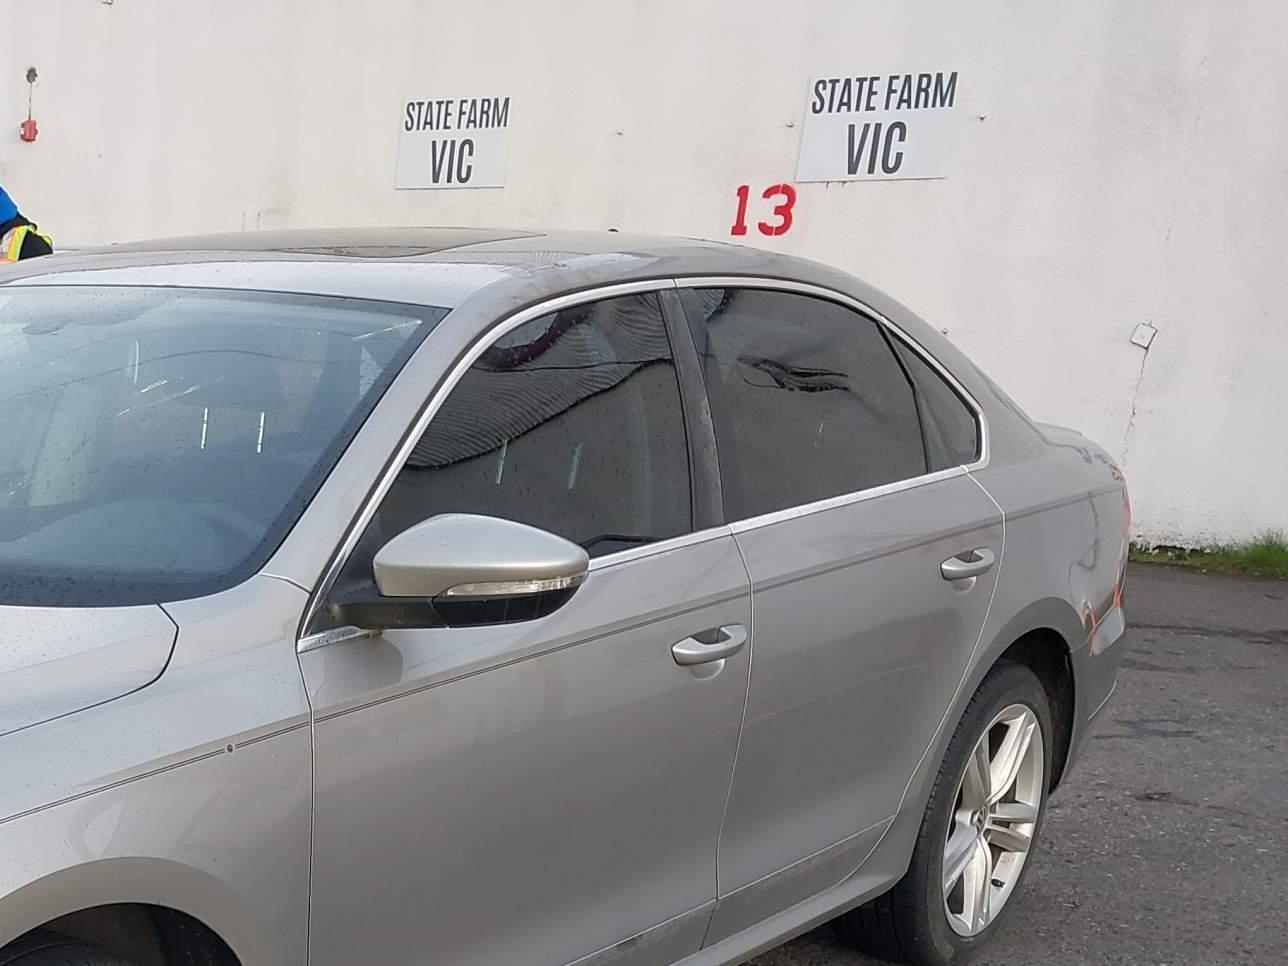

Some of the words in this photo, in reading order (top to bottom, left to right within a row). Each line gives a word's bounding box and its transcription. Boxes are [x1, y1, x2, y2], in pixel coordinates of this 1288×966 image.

[405, 100, 454, 131] STATE
[457, 97, 510, 129] FARM
[812, 77, 880, 114] STATE
[884, 72, 958, 110] FARM
[431, 138, 474, 183] VIC
[847, 121, 907, 175] VIC
[731, 184, 797, 236] 13
